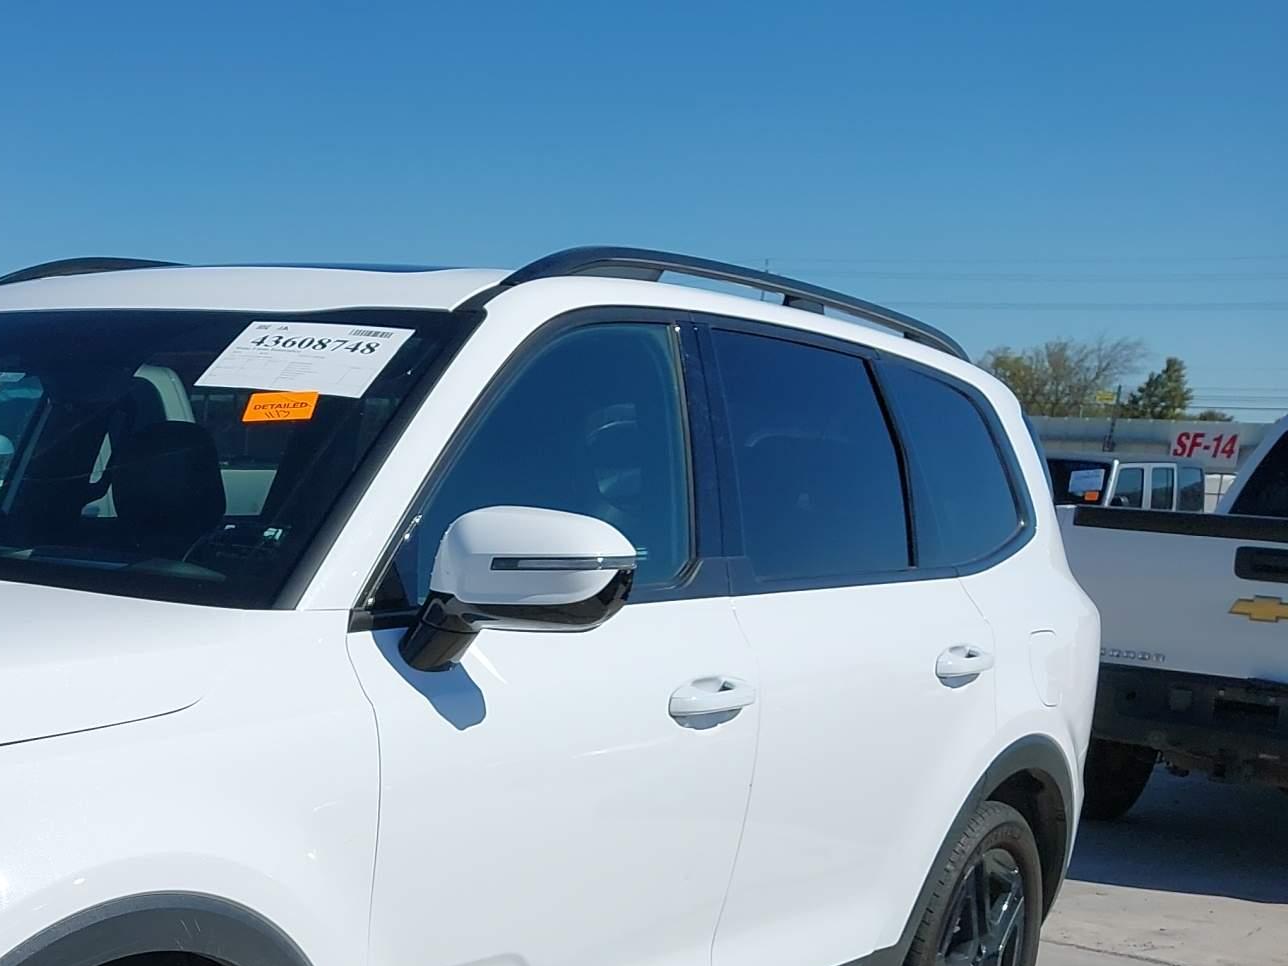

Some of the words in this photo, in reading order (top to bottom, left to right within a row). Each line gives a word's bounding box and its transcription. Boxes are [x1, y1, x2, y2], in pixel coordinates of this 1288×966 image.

[252, 334, 381, 355] 43608748
[253, 401, 309, 410] DETAILED
[1173, 432, 1238, 458] SF-14
